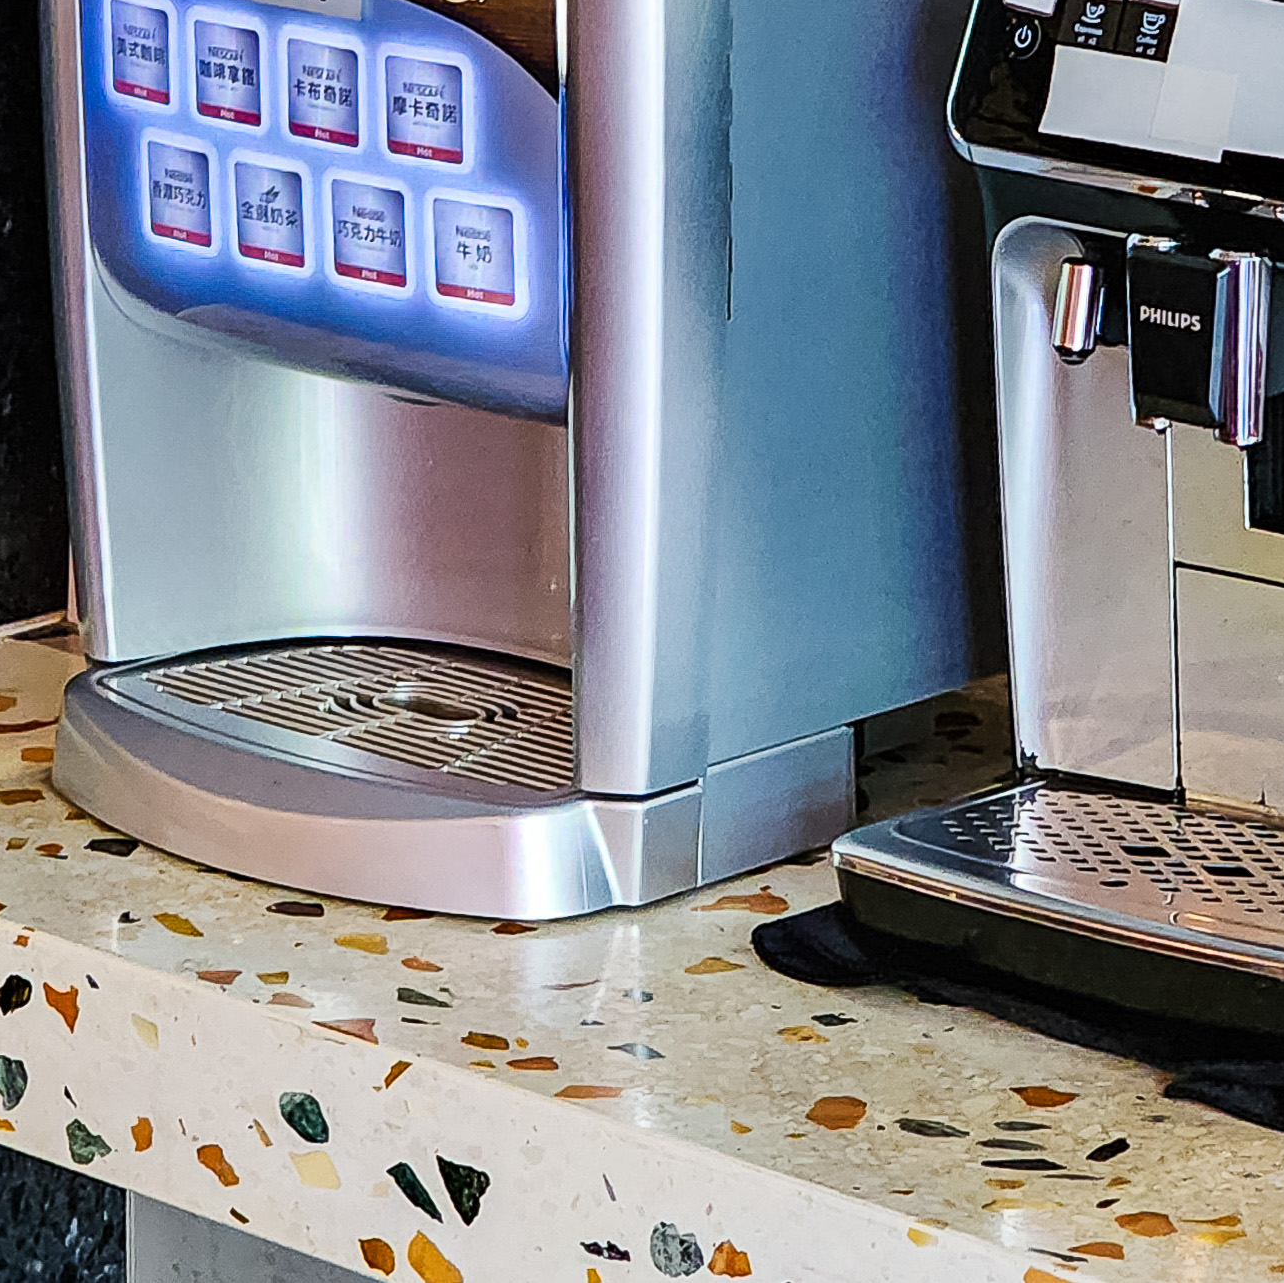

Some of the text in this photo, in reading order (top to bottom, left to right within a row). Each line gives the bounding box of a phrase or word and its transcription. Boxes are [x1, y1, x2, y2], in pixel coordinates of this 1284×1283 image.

[293, 78, 352, 107] 卡布奇諾
[392, 95, 457, 124] 摩卡奇諾
[337, 219, 402, 248] 巧克力牛奶
[455, 240, 492, 264] 牛奶
[1139, 305, 1201, 332] PHILIPS
